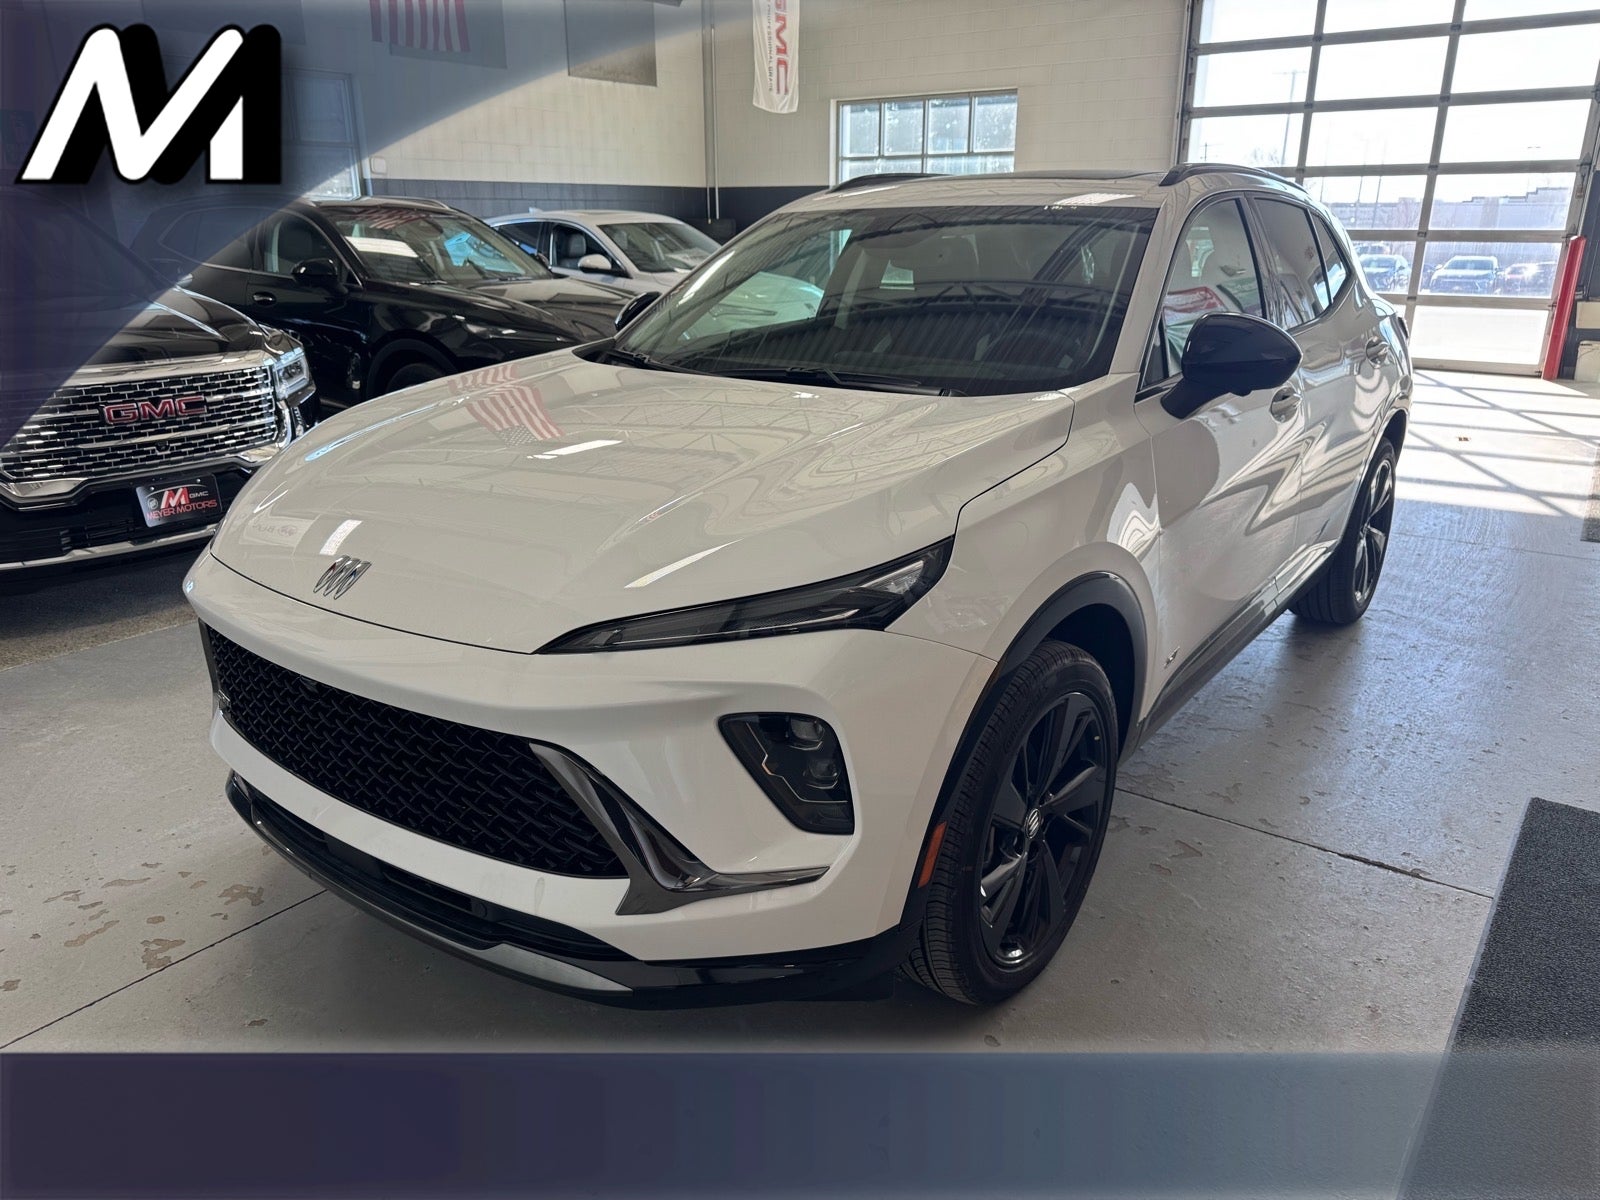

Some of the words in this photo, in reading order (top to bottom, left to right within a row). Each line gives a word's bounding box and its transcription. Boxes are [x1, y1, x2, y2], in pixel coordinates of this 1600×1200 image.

[102, 396, 207, 425] GMC
[188, 490, 209, 499] GMC
[146, 507, 175, 520] MEYER
[176, 499, 218, 513] MOTORS
